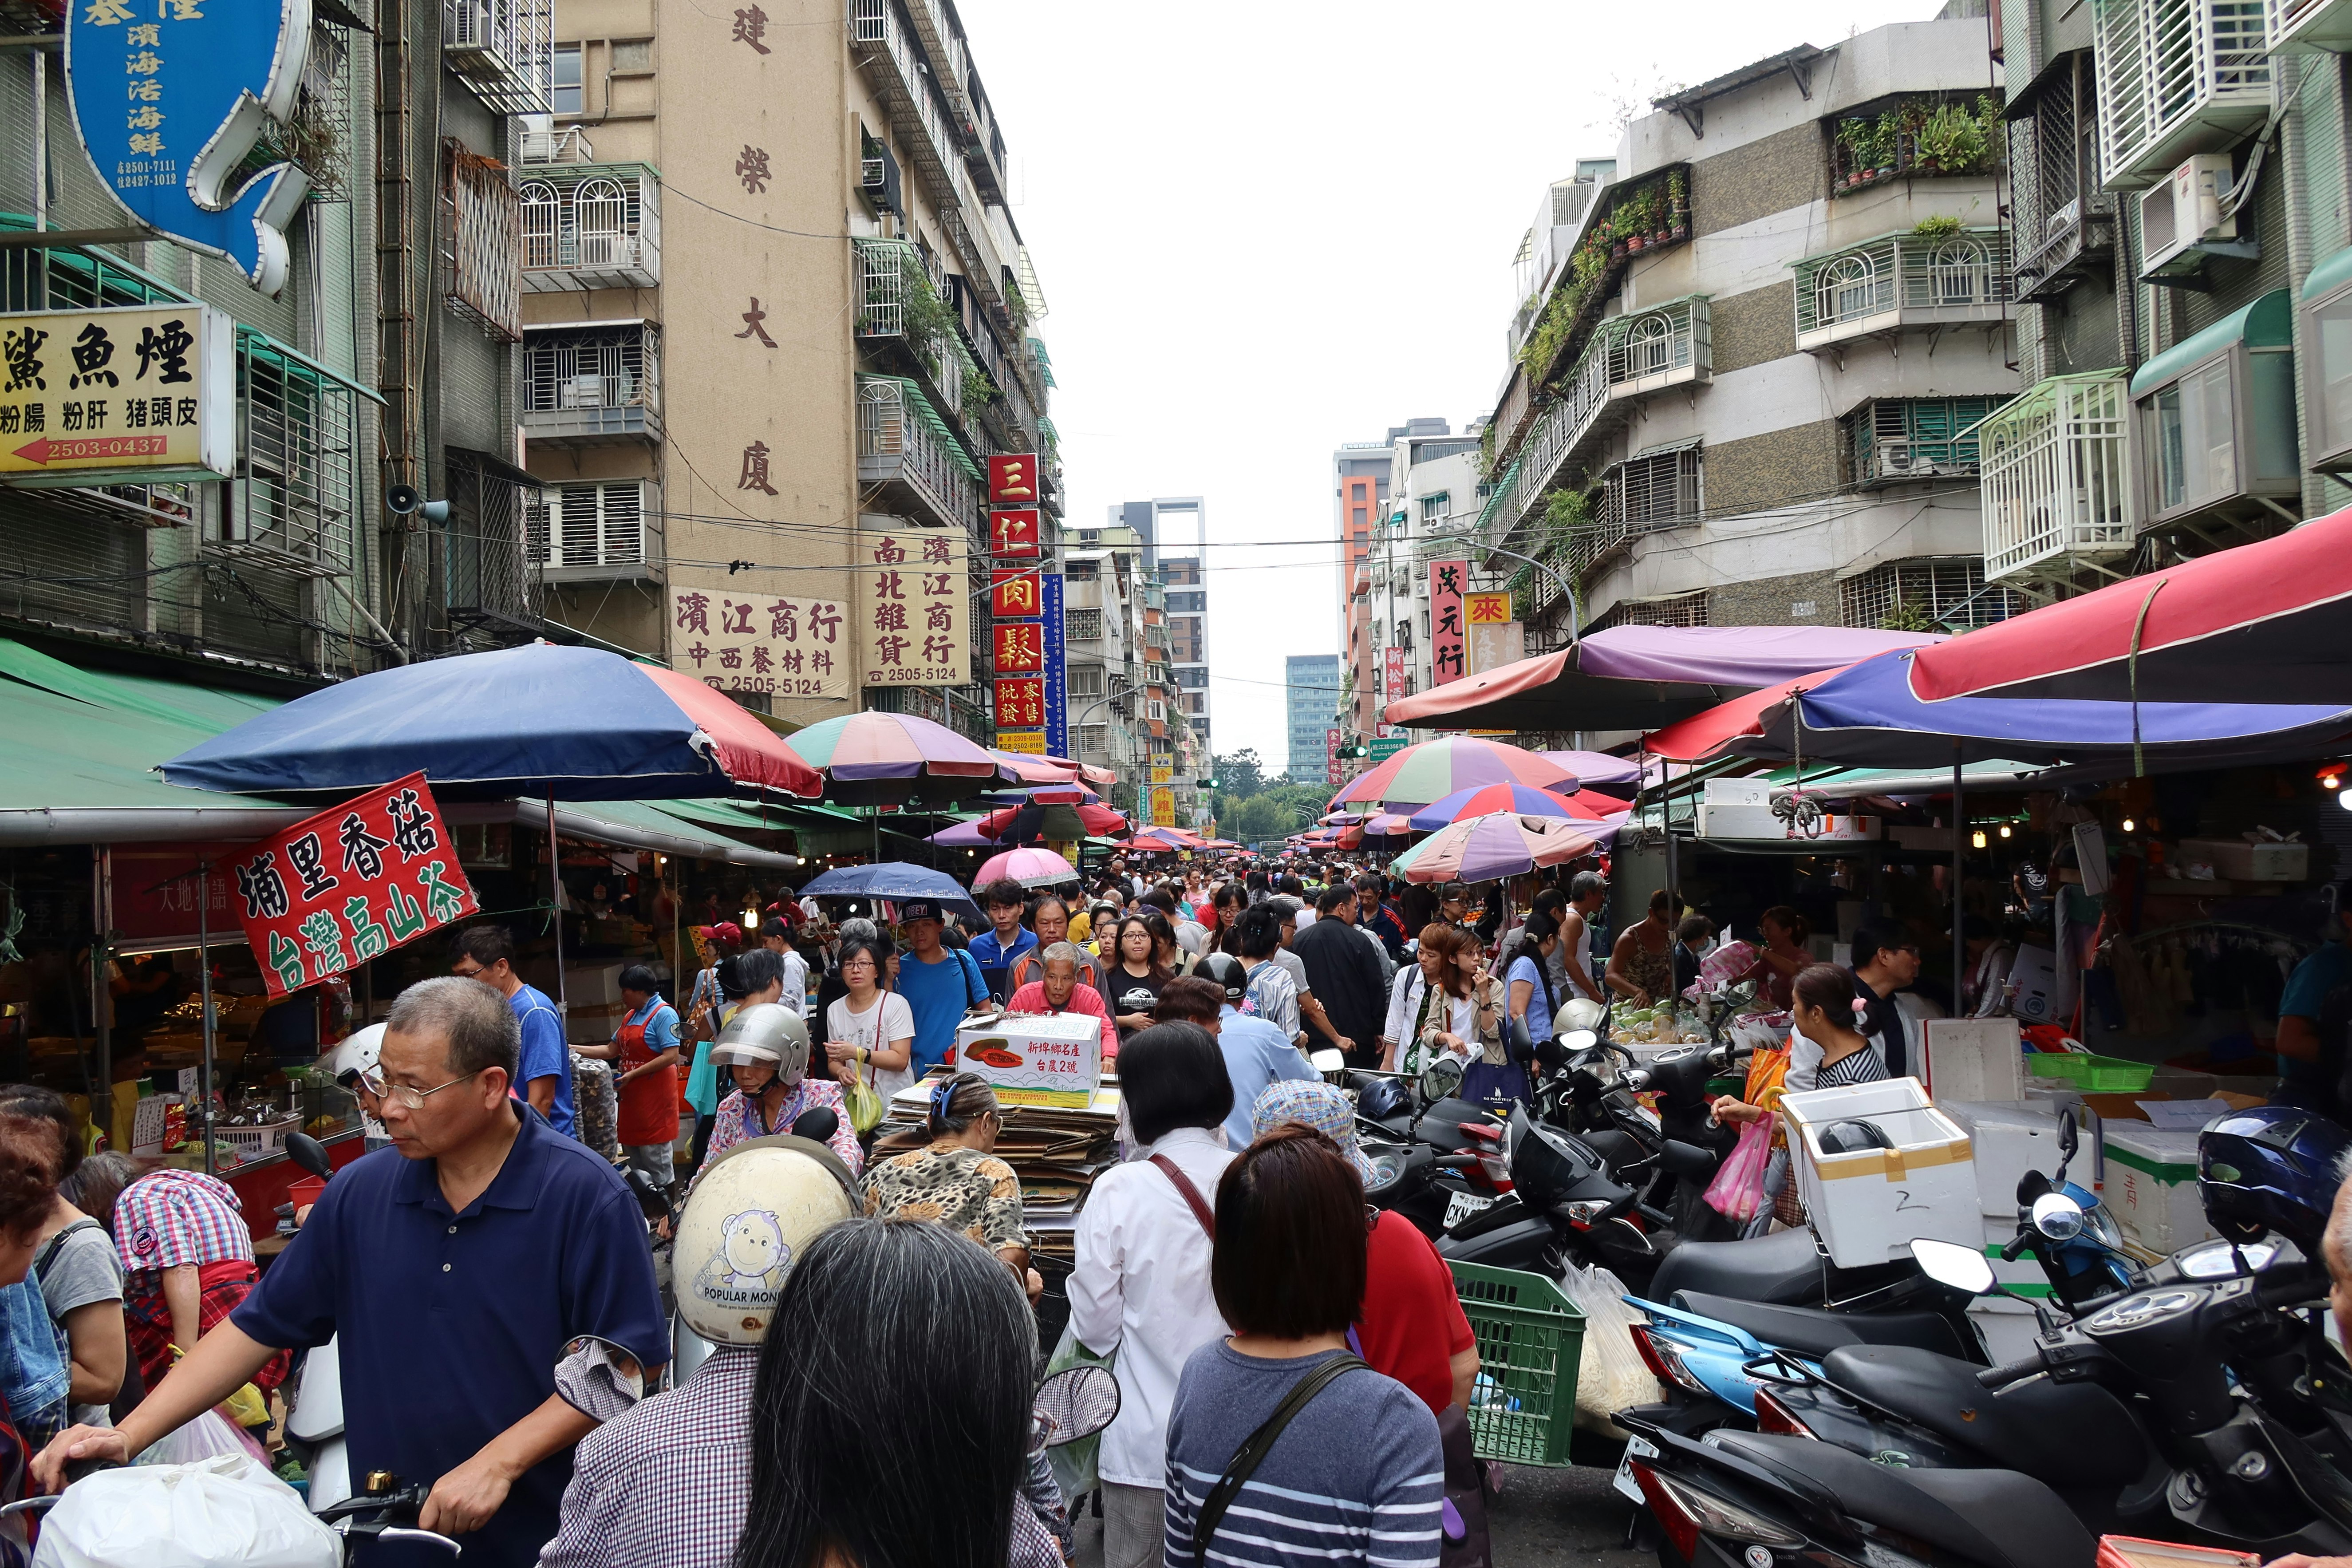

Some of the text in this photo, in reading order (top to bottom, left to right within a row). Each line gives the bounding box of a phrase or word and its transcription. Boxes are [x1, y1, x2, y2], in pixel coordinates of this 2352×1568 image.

[126, 24, 166, 157] 濱海活海鮮
[732, 4, 778, 496] 建榮大廈
[4, 319, 194, 394] 鯊魚煙
[0, 403, 45, 434] 粉腸
[63, 400, 108, 431] 粉肝
[47, 438, 162, 458] 2503-0437
[996, 462, 1040, 668] 三仁肉鬆
[874, 536, 911, 666] 南北雜貨
[922, 536, 955, 664] 濱江商行
[1472, 597, 1503, 621] 來
[676, 592, 843, 644] 濱江商行
[688, 641, 835, 676] 中西餐材料
[888, 667, 957, 681] 2505-5124
[731, 675, 822, 695] 2505-5124
[235, 788, 438, 919] 埔里香菇
[268, 860, 466, 992] 台灣高山茶
[907, 905, 926, 916] OBEY
[1028, 1041, 1081, 1057] 新埤鄉名產
[1037, 1059, 1078, 1074] 台農2號
[704, 1287, 782, 1303] POPULAR MON
[1701, 1435, 1720, 1449] SYM
